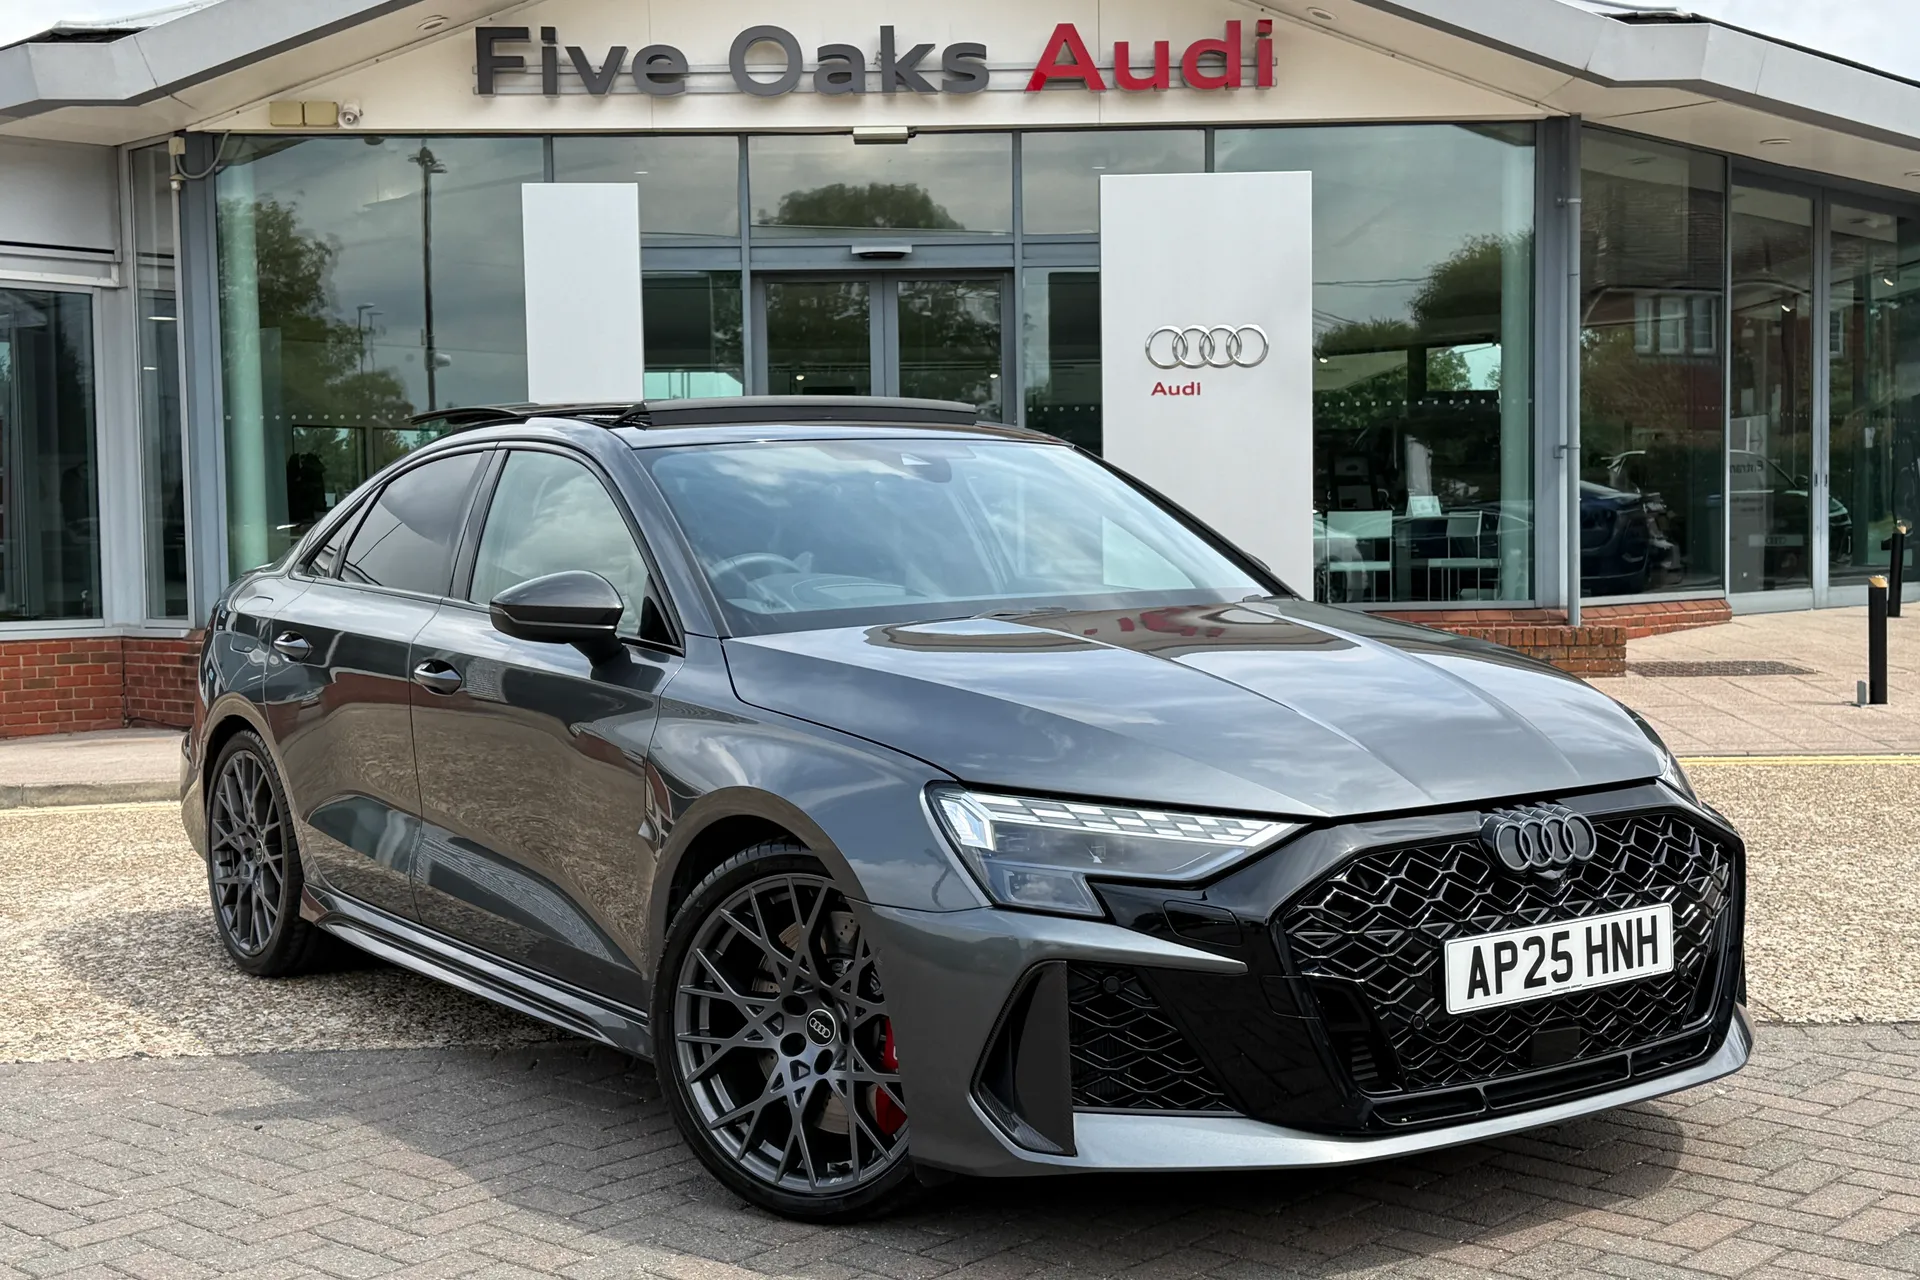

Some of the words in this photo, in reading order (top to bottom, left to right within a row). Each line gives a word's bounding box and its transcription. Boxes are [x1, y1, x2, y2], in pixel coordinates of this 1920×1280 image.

[475, 26, 689, 97] Five
[729, 25, 990, 97] Oaks
[1024, 19, 1273, 93] Audi
[1151, 381, 1201, 396] Audi
[1466, 930, 1573, 1000] AP25
[1585, 914, 1659, 978] HNH
